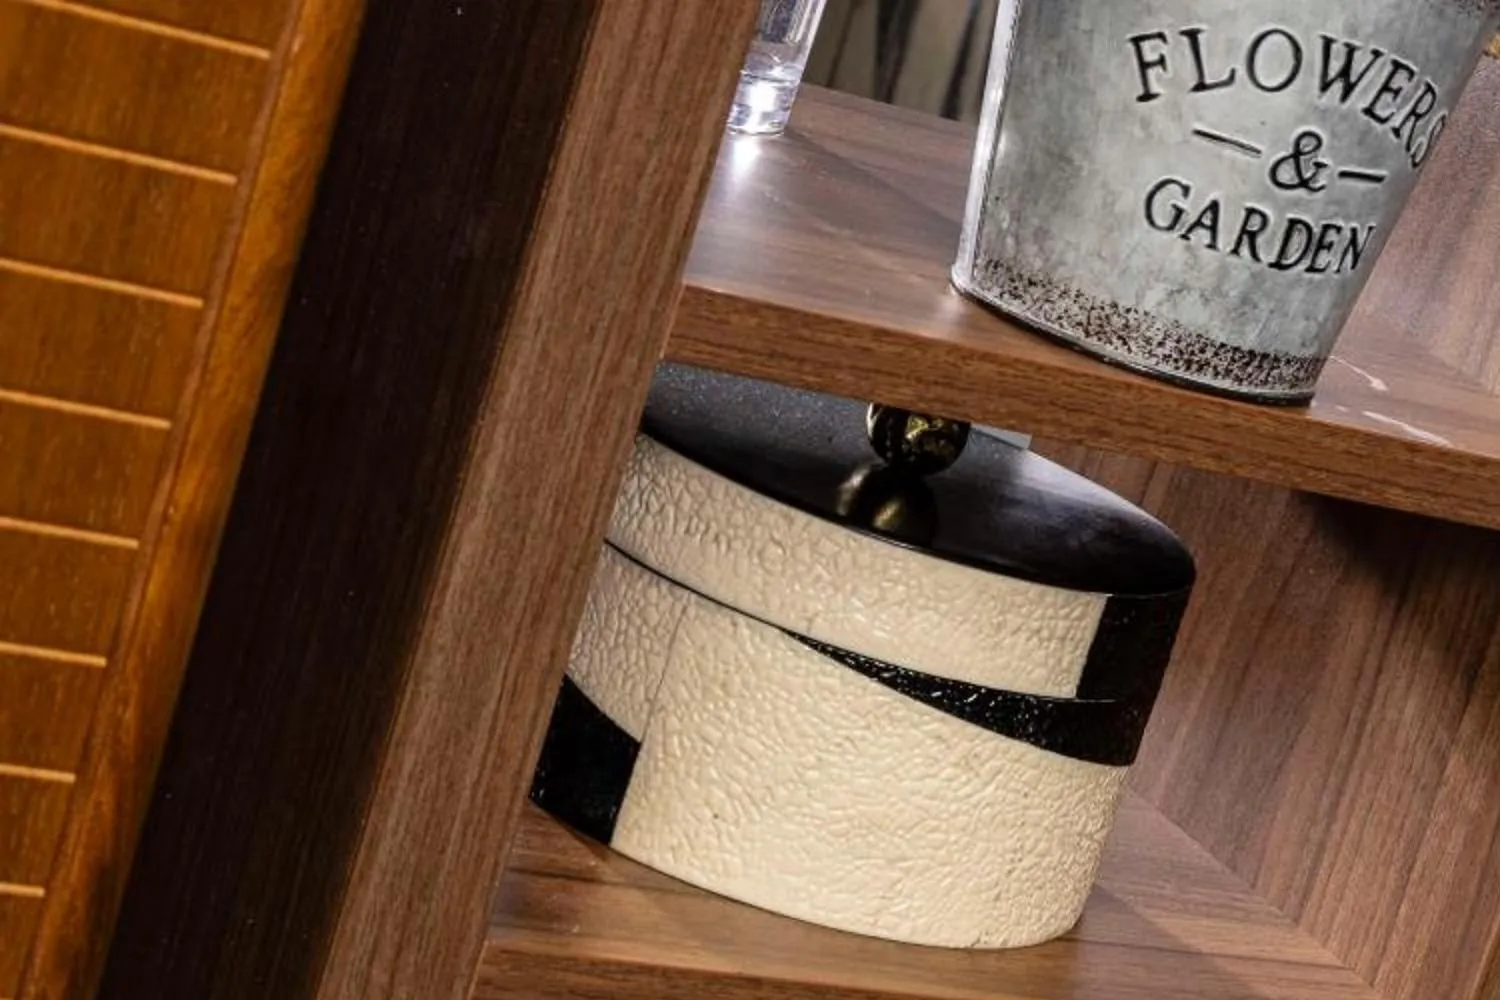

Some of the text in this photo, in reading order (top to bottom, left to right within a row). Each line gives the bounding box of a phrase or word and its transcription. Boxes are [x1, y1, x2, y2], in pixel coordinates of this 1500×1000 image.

[1129, 27, 1447, 170] FLOWERS
[1269, 130, 1328, 193] &
[1144, 177, 1375, 274] GARDEN
